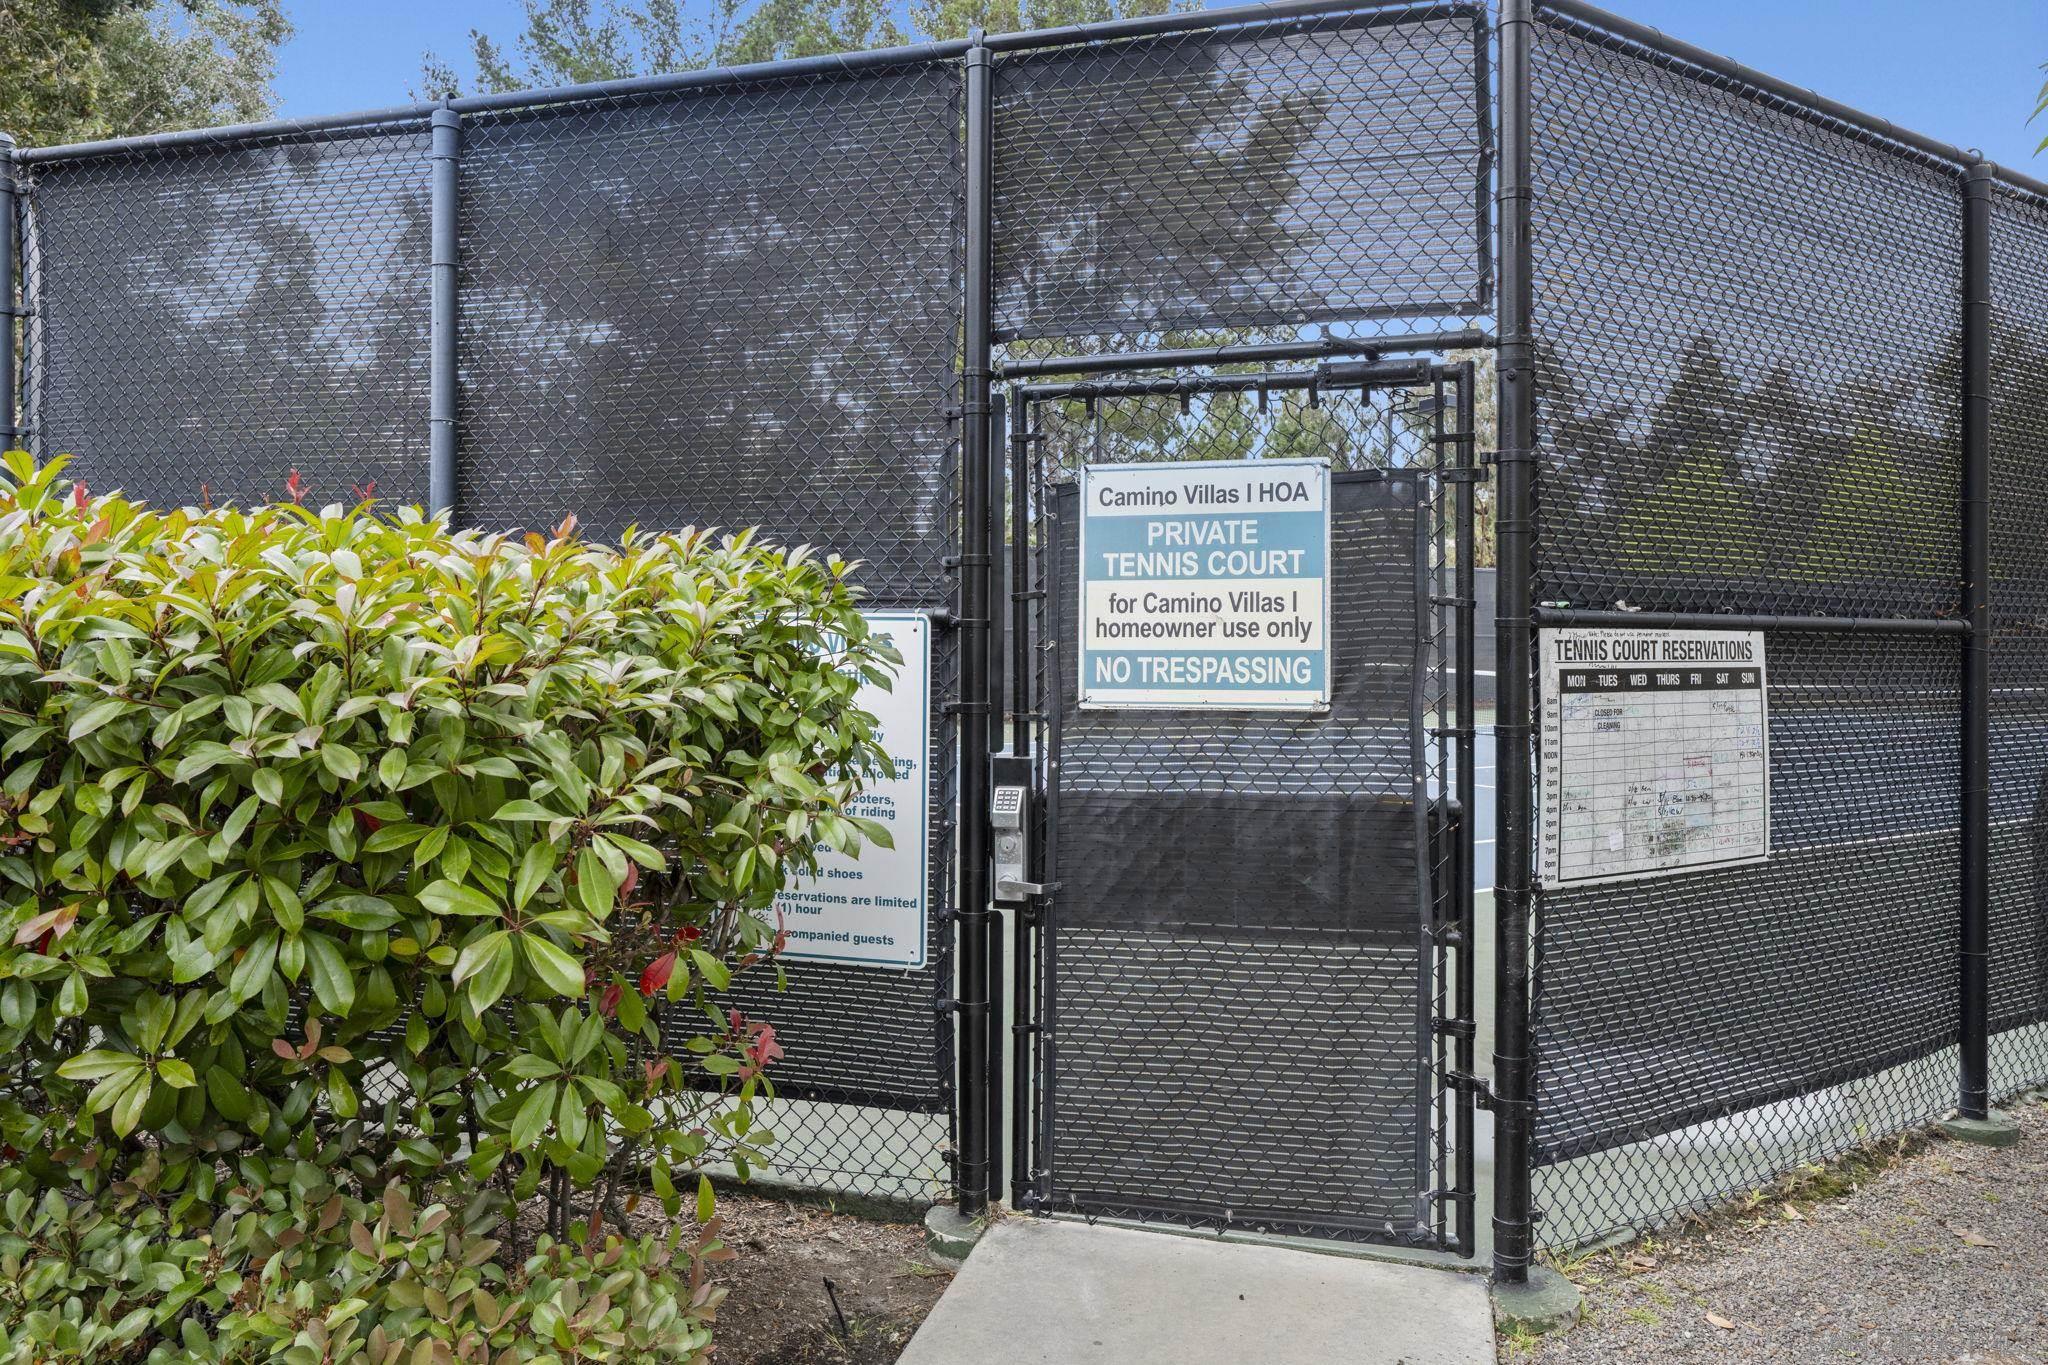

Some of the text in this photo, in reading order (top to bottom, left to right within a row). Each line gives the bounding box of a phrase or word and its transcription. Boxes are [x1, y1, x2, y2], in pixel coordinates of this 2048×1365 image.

[1099, 486, 1178, 506] Camino
[1184, 483, 1240, 504] Villas
[1259, 481, 1310, 502] HOA
[1147, 520, 1259, 546] PRIVATE
[1102, 549, 1305, 577] TENNIS COURT
[1108, 593, 1137, 614] for
[1143, 592, 1222, 614] Camino
[1228, 591, 1285, 613] Villas
[1096, 616, 1313, 643] homeowner use only
[1555, 639, 1753, 661] TENNIS COURT RESERVATIONS
[1095, 656, 1312, 684] NO TRESPASSING
[1567, 672, 1755, 687] MON TUES WED THURS FRI SAT SUN
[1546, 697, 1558, 705] 8am
[1546, 711, 1558, 719] 9am
[1594, 708, 1623, 717] CLOSED FOR
[1597, 721, 1621, 730] CLEANING
[1543, 751, 1558, 759] NOON
[1547, 766, 1558, 774] 1pm
[1546, 779, 1558, 787] 2pm
[852, 794, 895, 807] ooters,
[1546, 793, 1558, 801] 3pm
[844, 806, 857, 816] of
[861, 806, 896, 820] riding
[1546, 806, 1558, 815] 4pm
[1545, 820, 1557, 828] 5pm
[1545, 833, 1557, 842] 6pm
[1545, 847, 1556, 855] 7pm
[1544, 861, 1556, 869] 8pm
[797, 866, 824, 878] old
[827, 868, 863, 880] shoes
[851, 897, 871, 905] are
[874, 895, 917, 909] limited
[795, 903, 822, 915] hour
[853, 934, 894, 945] guests
